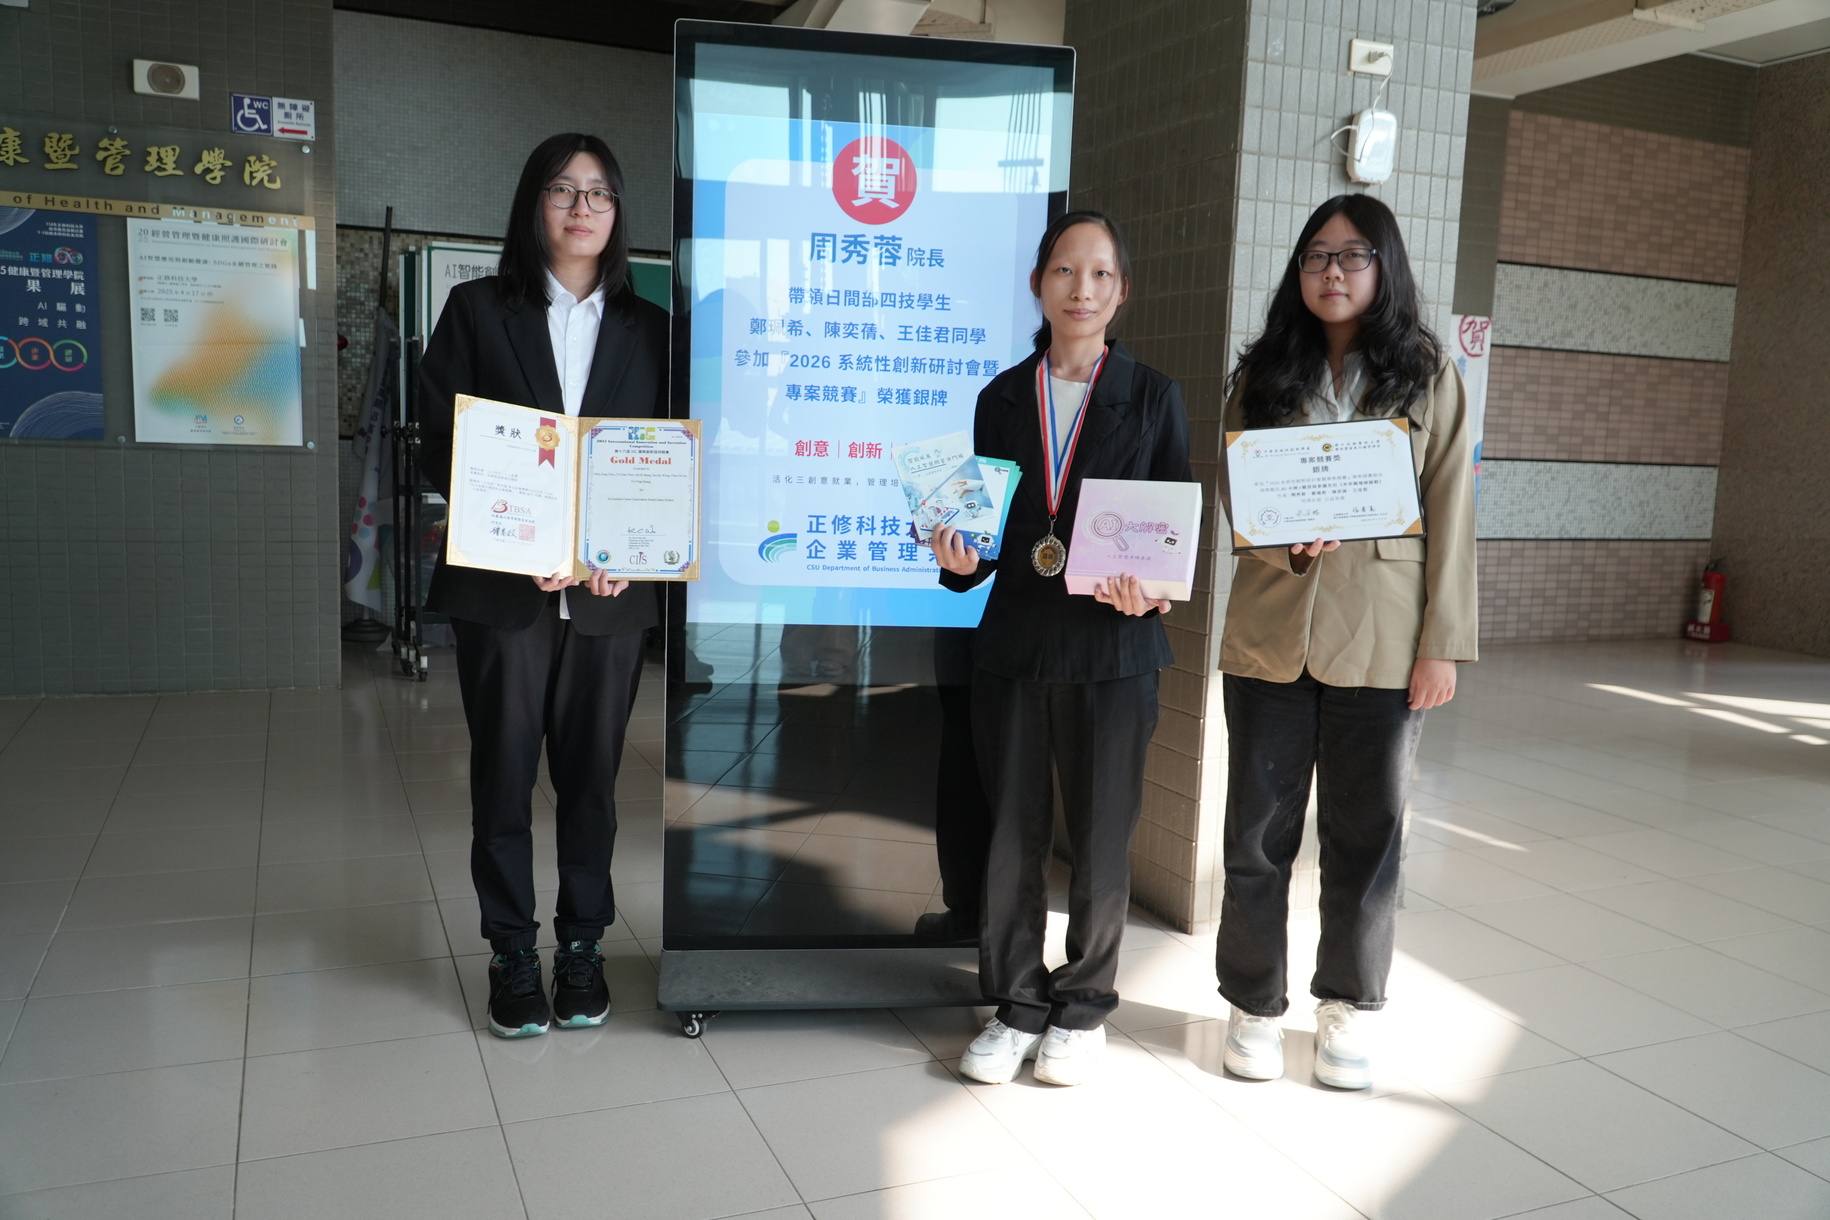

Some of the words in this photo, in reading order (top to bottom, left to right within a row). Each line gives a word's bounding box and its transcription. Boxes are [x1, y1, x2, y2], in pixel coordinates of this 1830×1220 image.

[253, 101, 269, 110] WC
[277, 102, 310, 113] 無障礙
[0, 127, 282, 190] 康暨管理學院
[852, 154, 900, 209] 賀
[13, 195, 32, 205] of
[45, 196, 113, 211] Health
[125, 205, 160, 215] and
[172, 206, 298, 226] Management
[809, 231, 903, 266] 周秀蓉
[906, 248, 945, 268] 院長
[38, 302, 48, 311] AI
[789, 286, 952, 311] 帶領日間部四技學生
[1461, 317, 1490, 352] 賀
[838, 354, 1000, 377] 系統性創新研討會暨
[495, 424, 522, 440] 獎狀
[794, 439, 830, 458] 創意
[848, 441, 883, 460] 創新
[610, 456, 635, 464] Gold
[638, 456, 672, 465] Medal
[508, 504, 532, 515] TBSA
[1098, 519, 1119, 532] AI
[822, 564, 861, 572] Department
